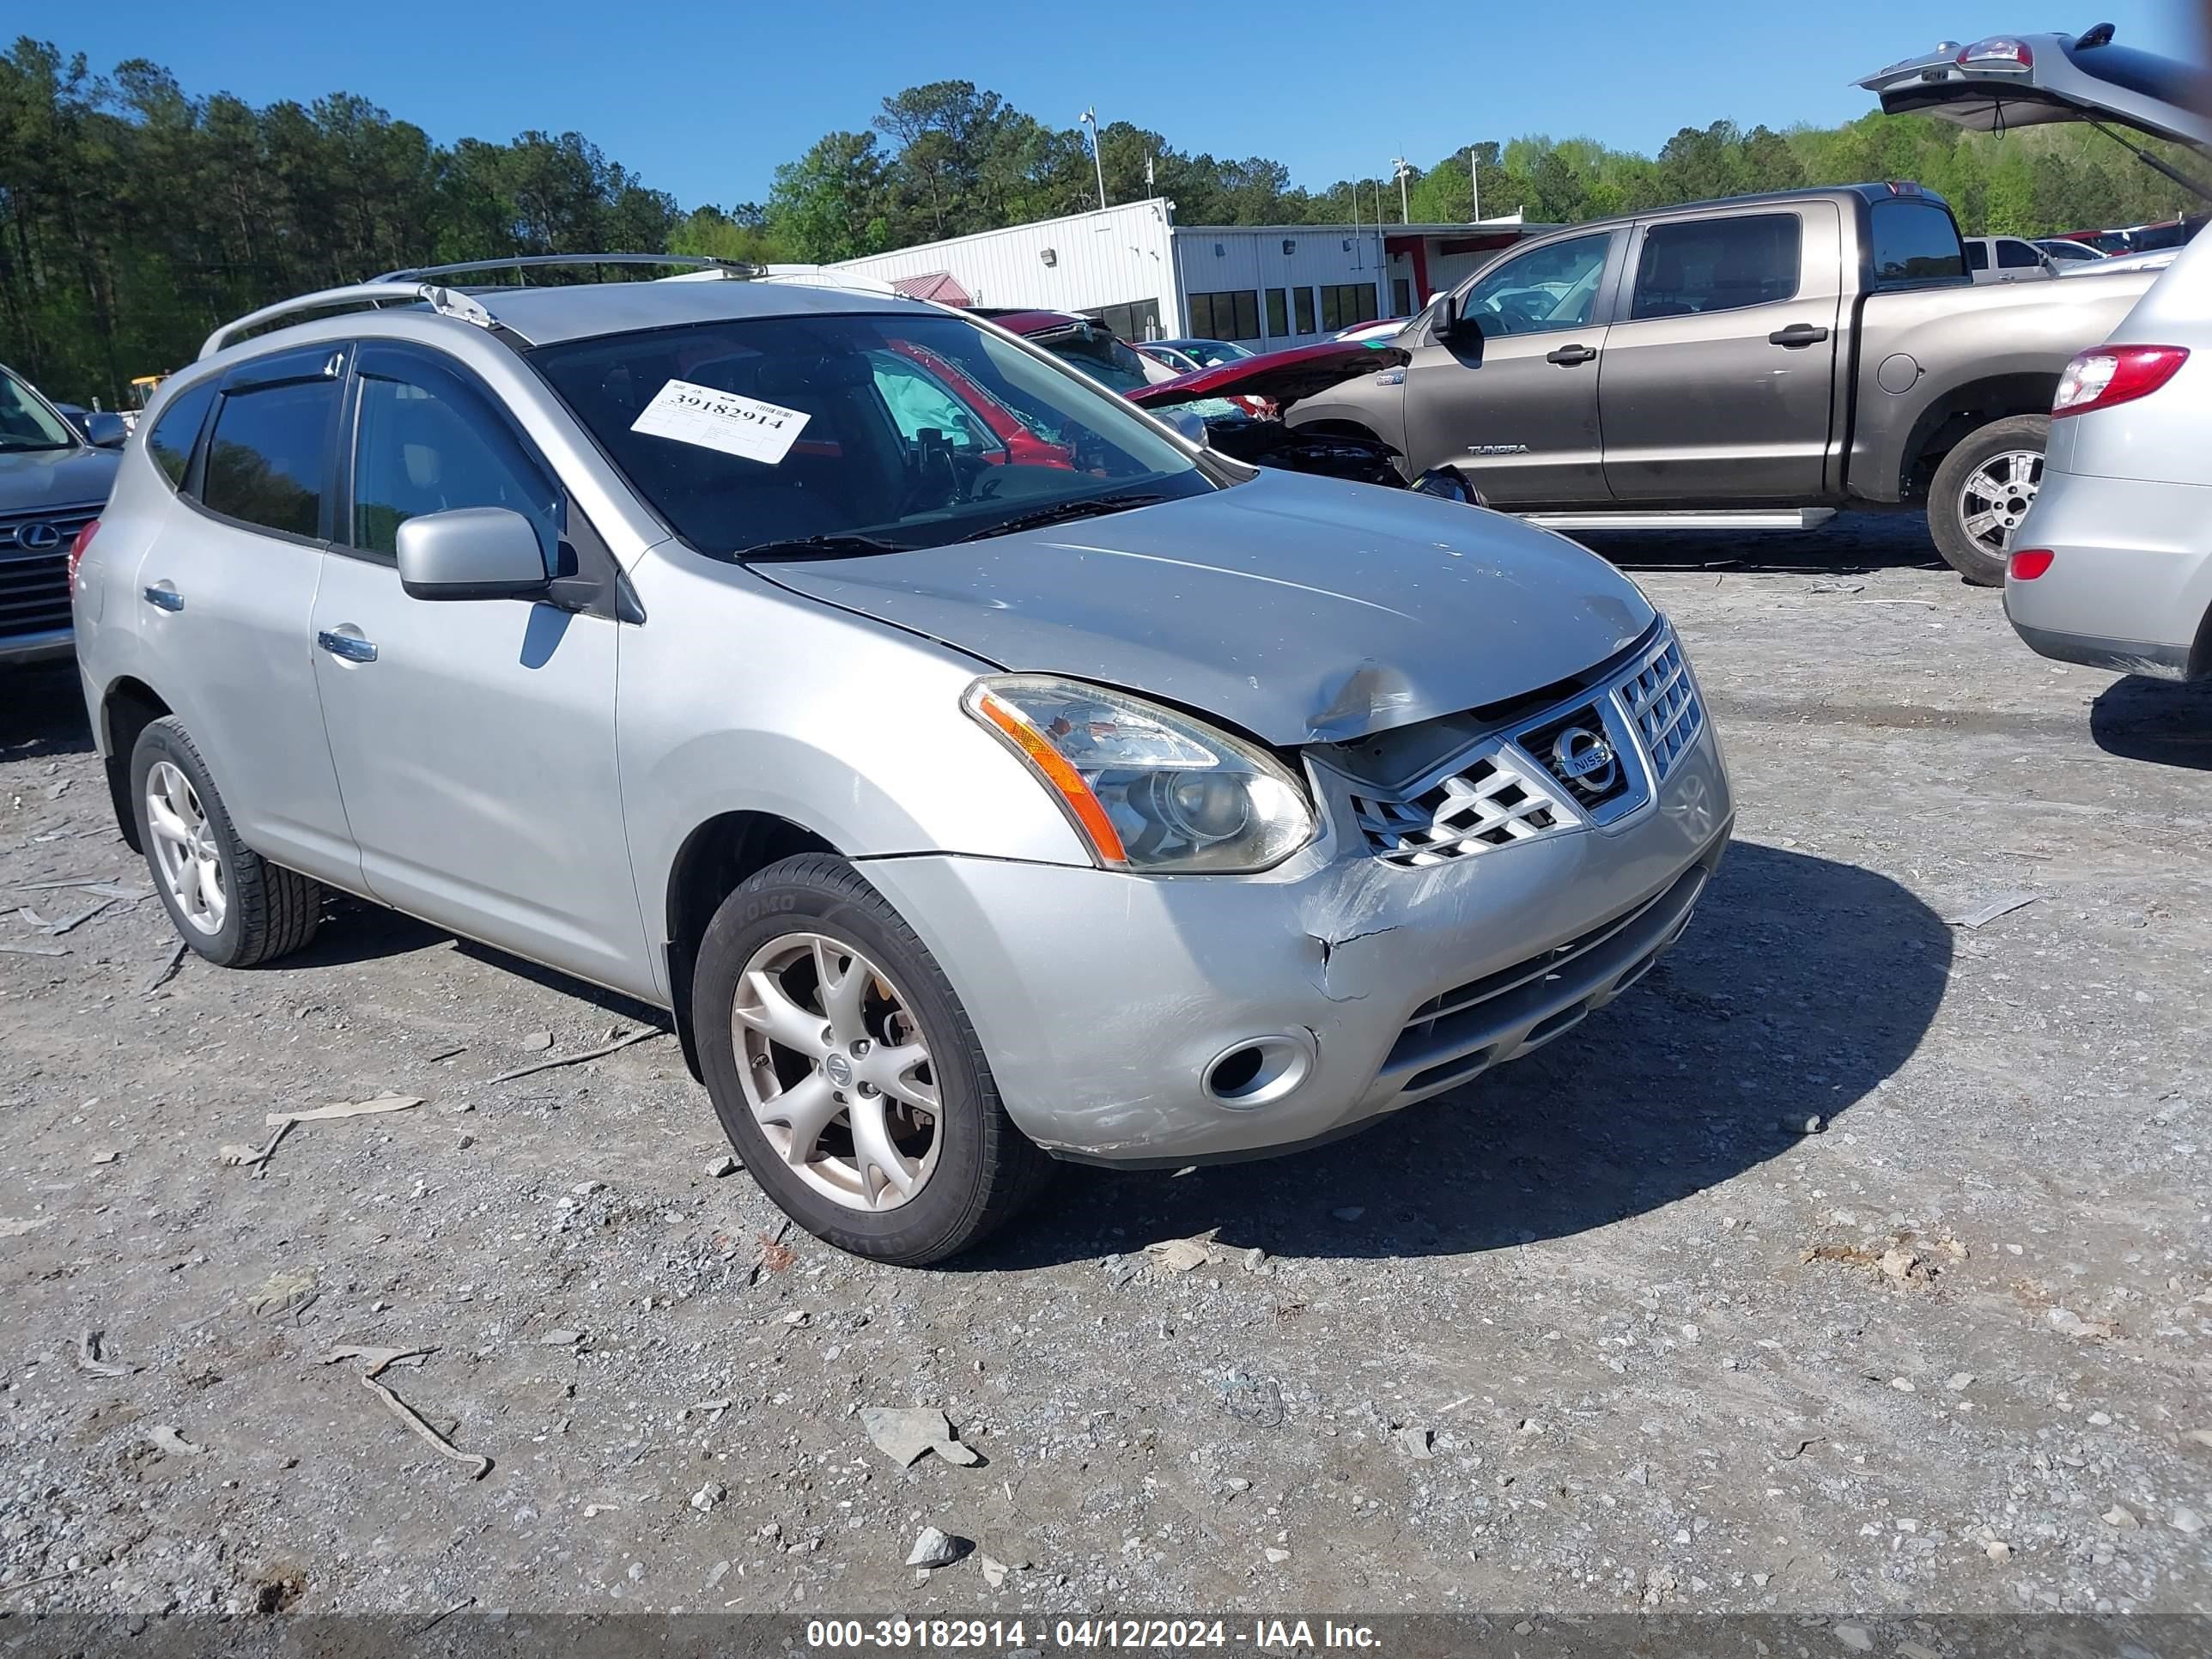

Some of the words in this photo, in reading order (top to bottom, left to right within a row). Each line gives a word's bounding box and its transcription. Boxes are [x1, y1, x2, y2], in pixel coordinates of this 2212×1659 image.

[670, 393, 784, 430] 39182914
[1468, 444, 1530, 456] TUNDRA
[1573, 750, 1607, 772] NISS
